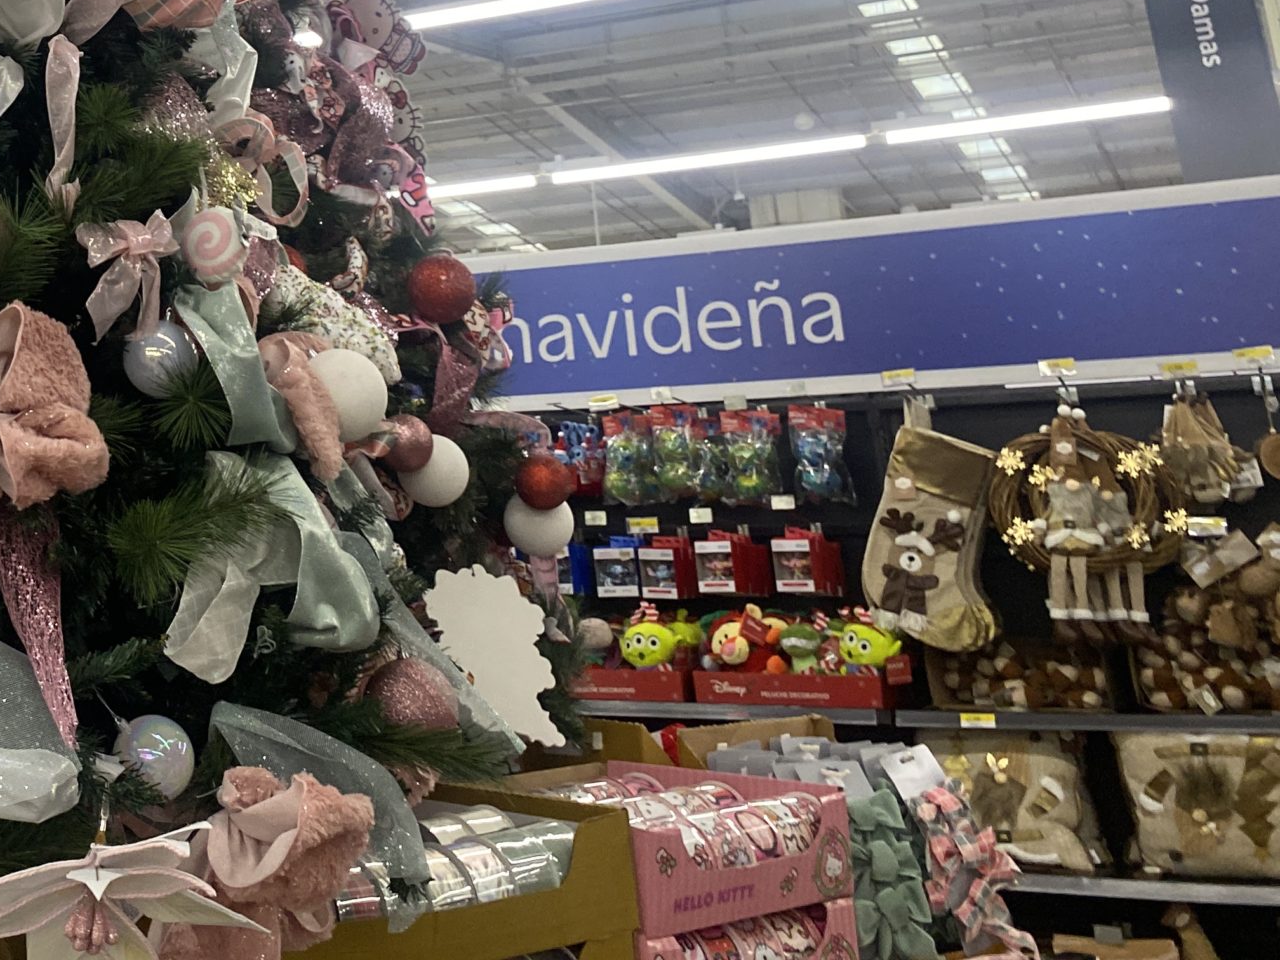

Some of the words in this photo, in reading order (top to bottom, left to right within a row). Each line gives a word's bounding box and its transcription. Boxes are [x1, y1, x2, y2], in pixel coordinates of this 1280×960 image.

[502, 279, 845, 364] navideña
[709, 679, 747, 697] Disney
[673, 891, 714, 914] HELLO
[717, 883, 755, 905] KITTY
